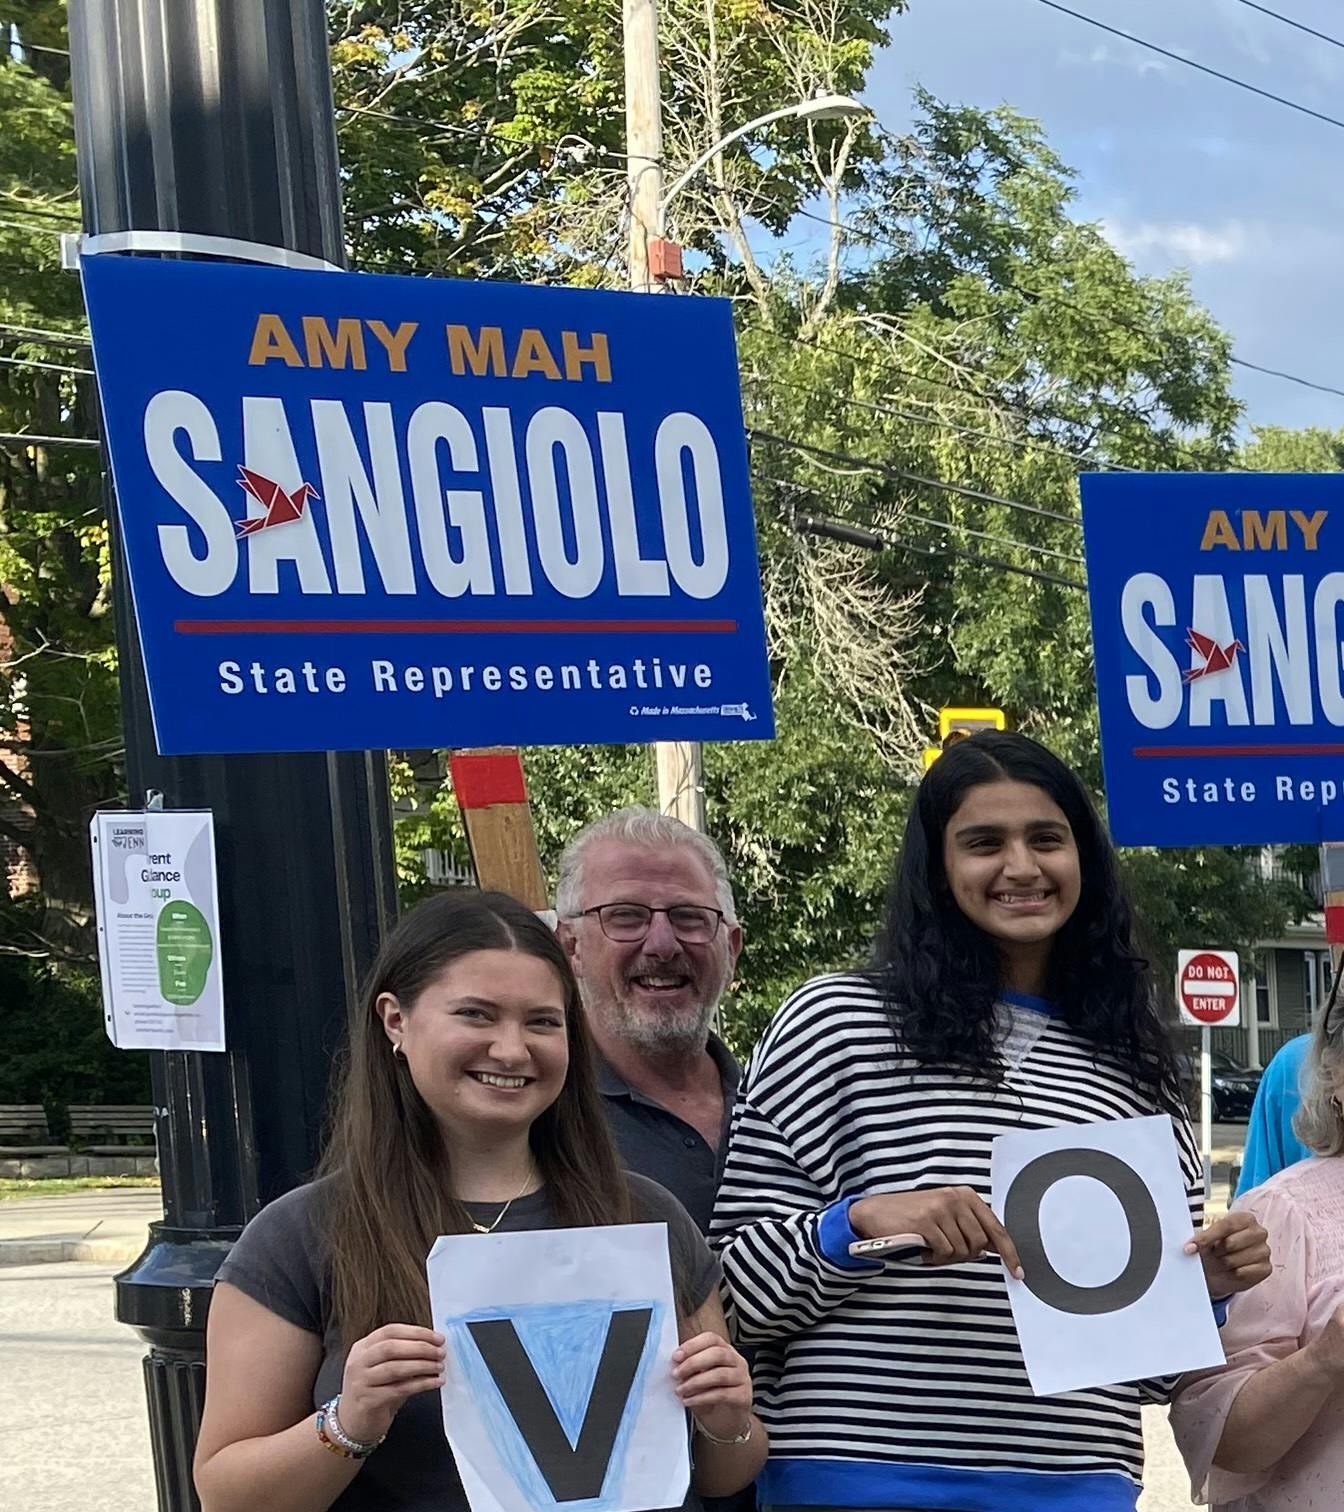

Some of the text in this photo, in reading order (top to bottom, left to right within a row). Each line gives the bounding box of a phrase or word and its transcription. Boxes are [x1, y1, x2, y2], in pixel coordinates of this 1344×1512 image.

[248, 314, 612, 382] AMY MAH
[143, 390, 730, 600] SANGIOLO
[1200, 511, 1328, 551] AMY
[219, 656, 713, 698] State Representative
[1162, 777, 1257, 804] State
[1188, 965, 1229, 980] DO NOT
[1192, 997, 1226, 1011] ENTER
[1003, 1147, 1164, 1316] O
[464, 1307, 654, 1504] V
